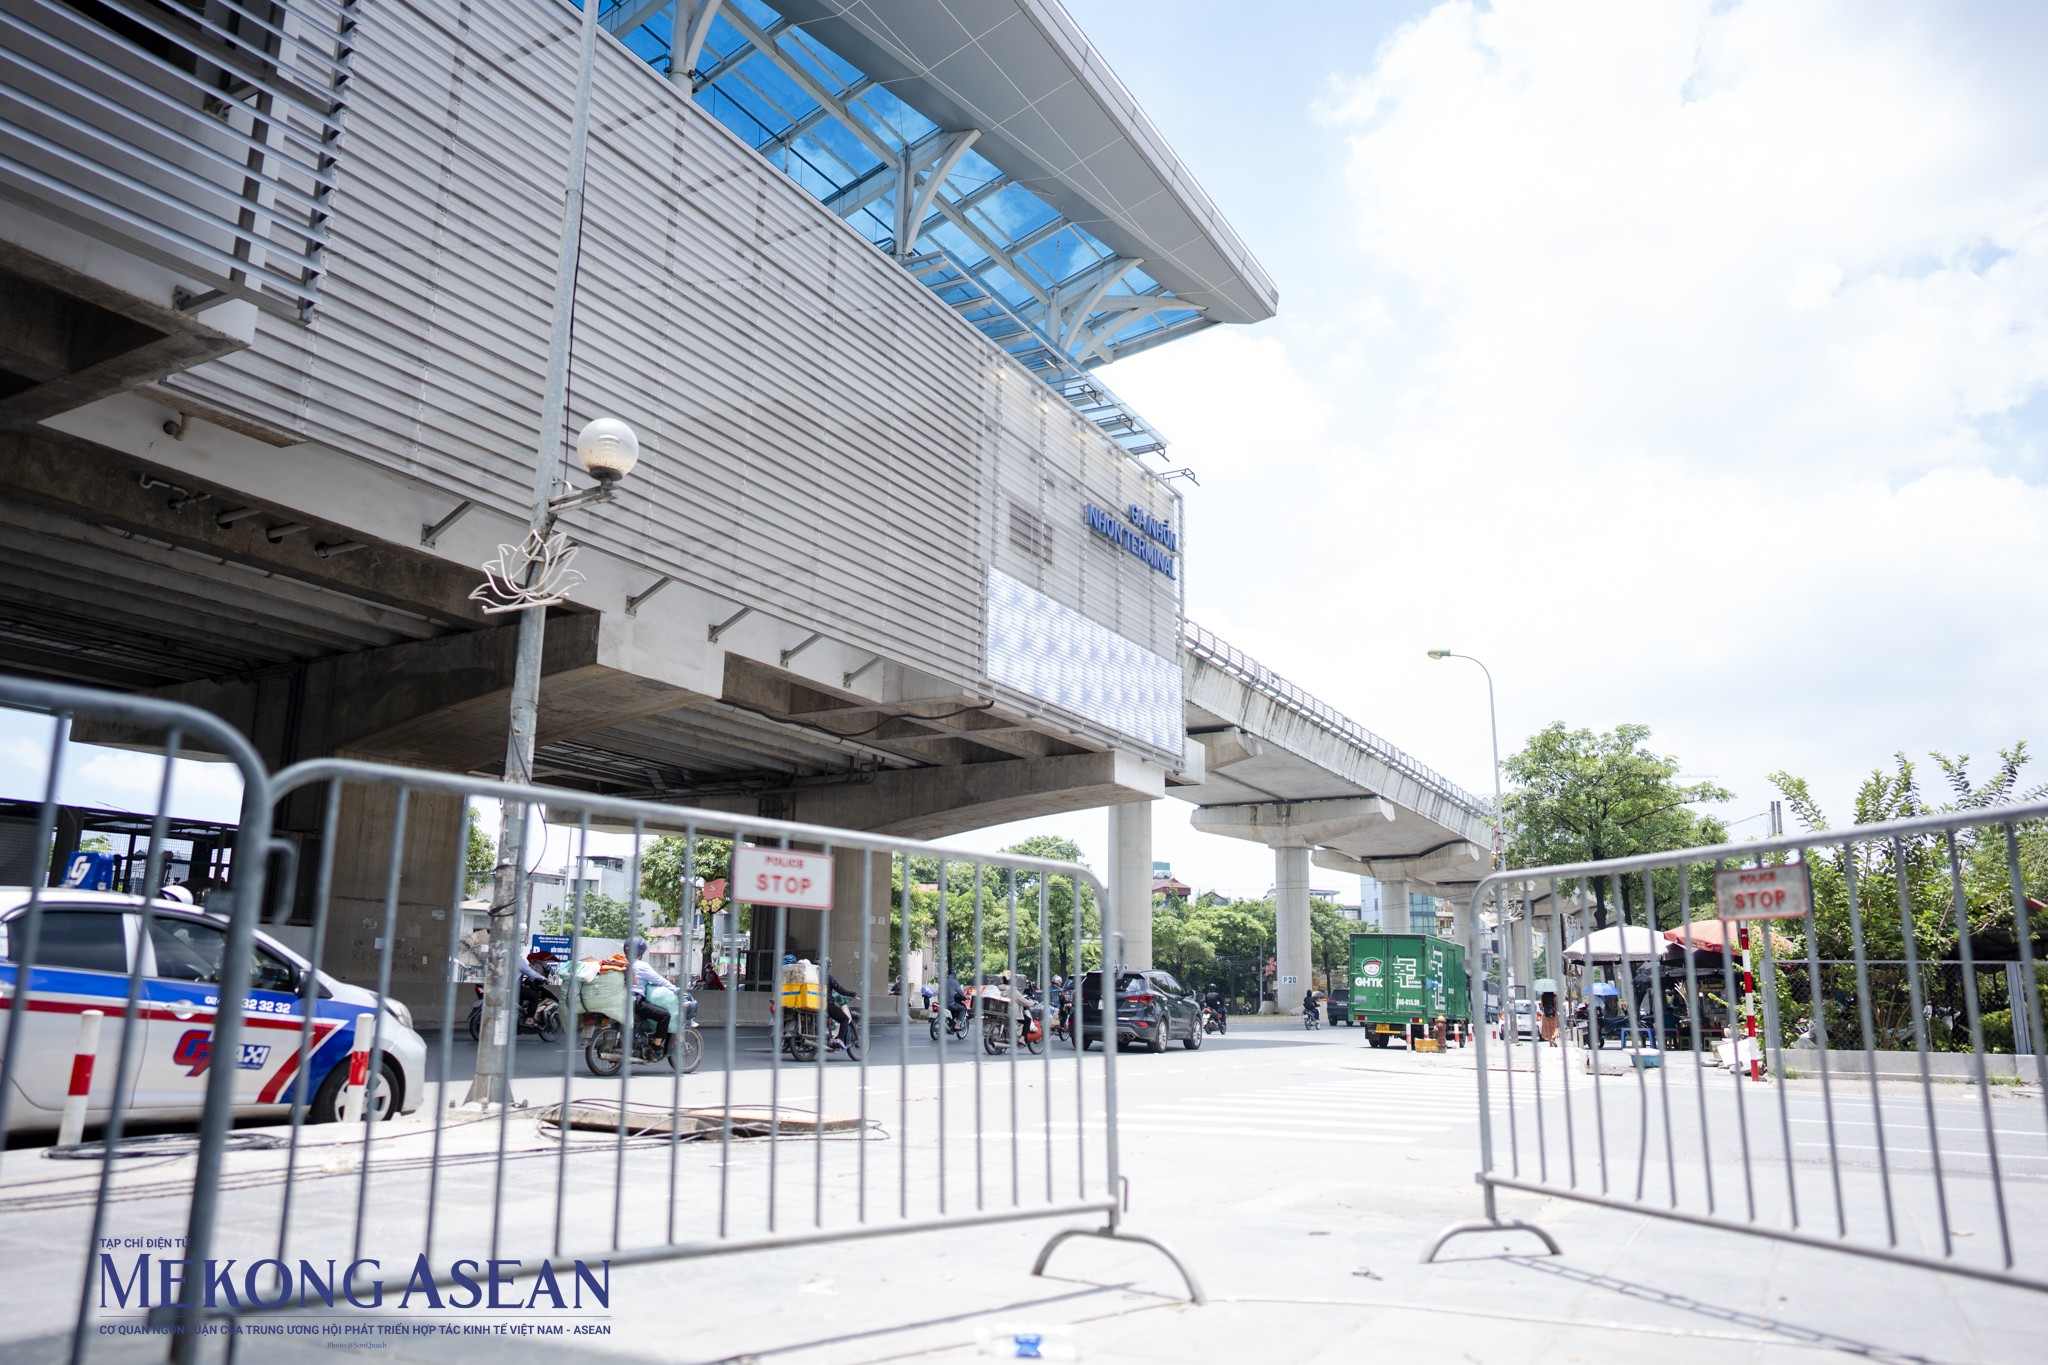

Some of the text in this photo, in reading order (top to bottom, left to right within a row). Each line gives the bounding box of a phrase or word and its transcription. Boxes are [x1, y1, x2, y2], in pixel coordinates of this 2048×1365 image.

[1128, 503, 1147, 534] GA
[1083, 502, 1177, 580] NHON TERMINAL
[756, 873, 812, 895] STOP
[1739, 871, 1776, 883] POLICE
[1734, 888, 1785, 910] STOP
[1354, 977, 1383, 988] GHTK
[258, 1000, 275, 1012] 32
[274, 1002, 292, 1014] 32
[236, 1044, 269, 1063] AXI
